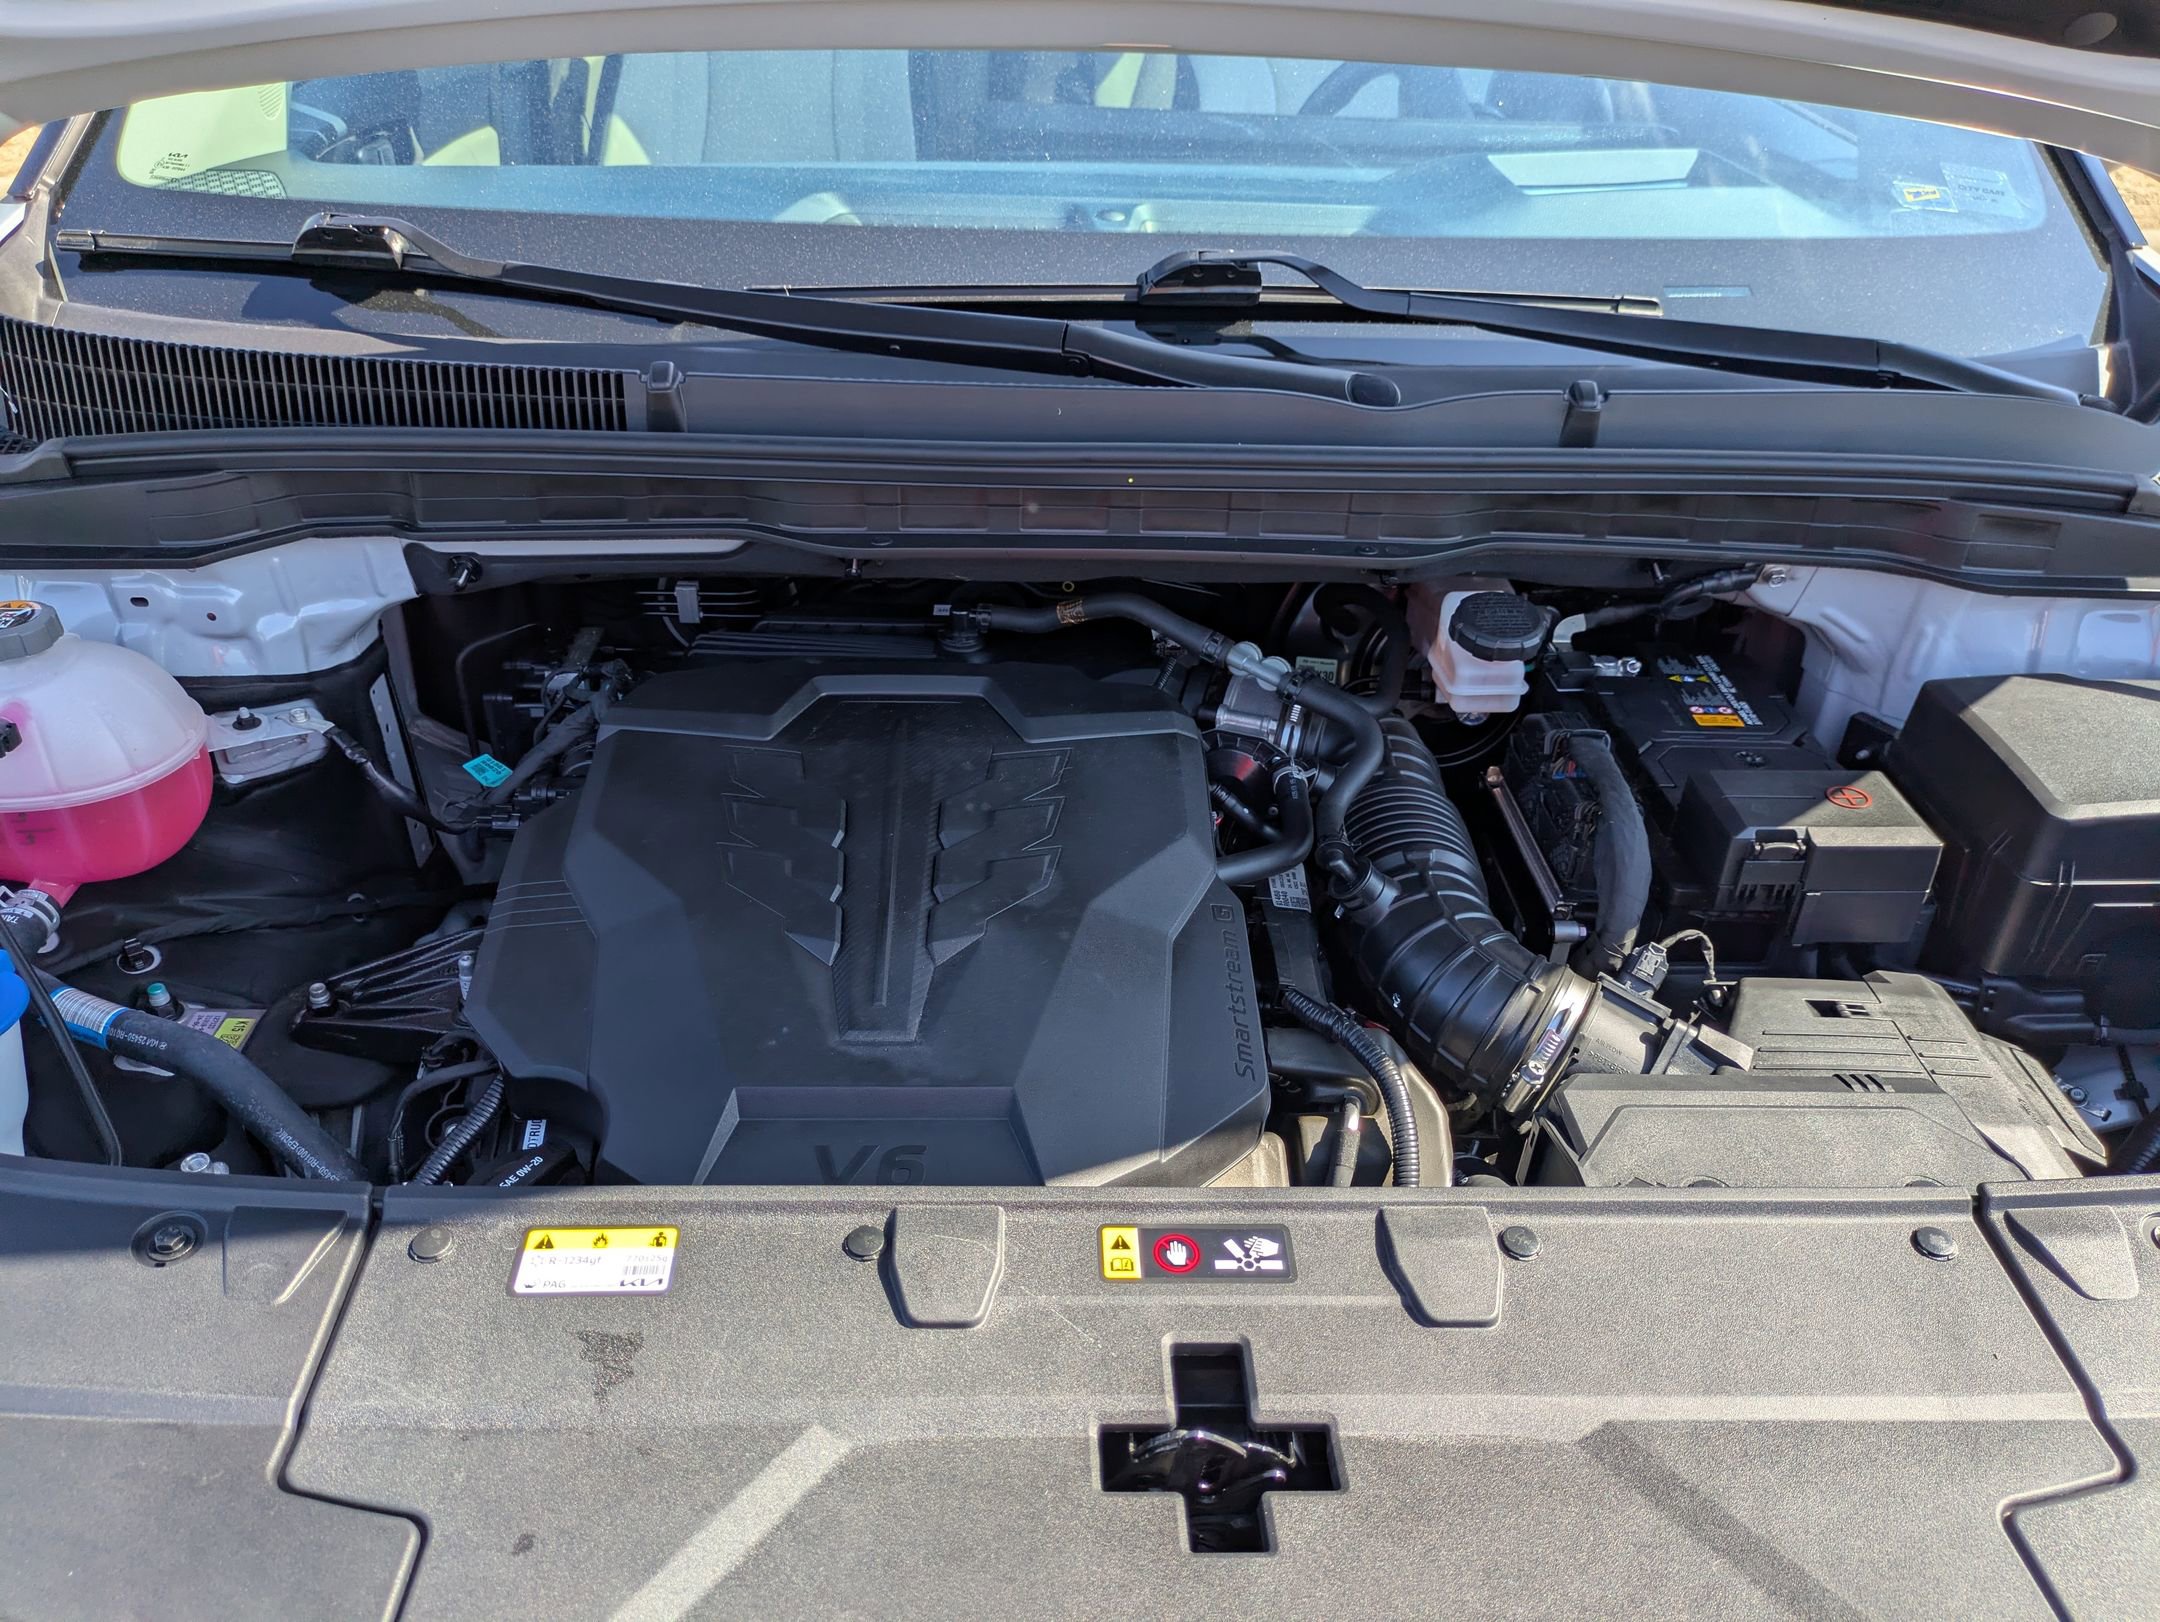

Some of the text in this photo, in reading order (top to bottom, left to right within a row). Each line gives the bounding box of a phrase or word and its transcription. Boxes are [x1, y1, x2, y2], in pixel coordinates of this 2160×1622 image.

[1221, 929, 1256, 1082] Smartstream
[231, 1020, 250, 1032] K15
[516, 1155, 544, 1178] 0W-20
[815, 1144, 928, 1185] V6
[542, 1280, 567, 1289] PAG
[619, 1278, 664, 1288] KIA
